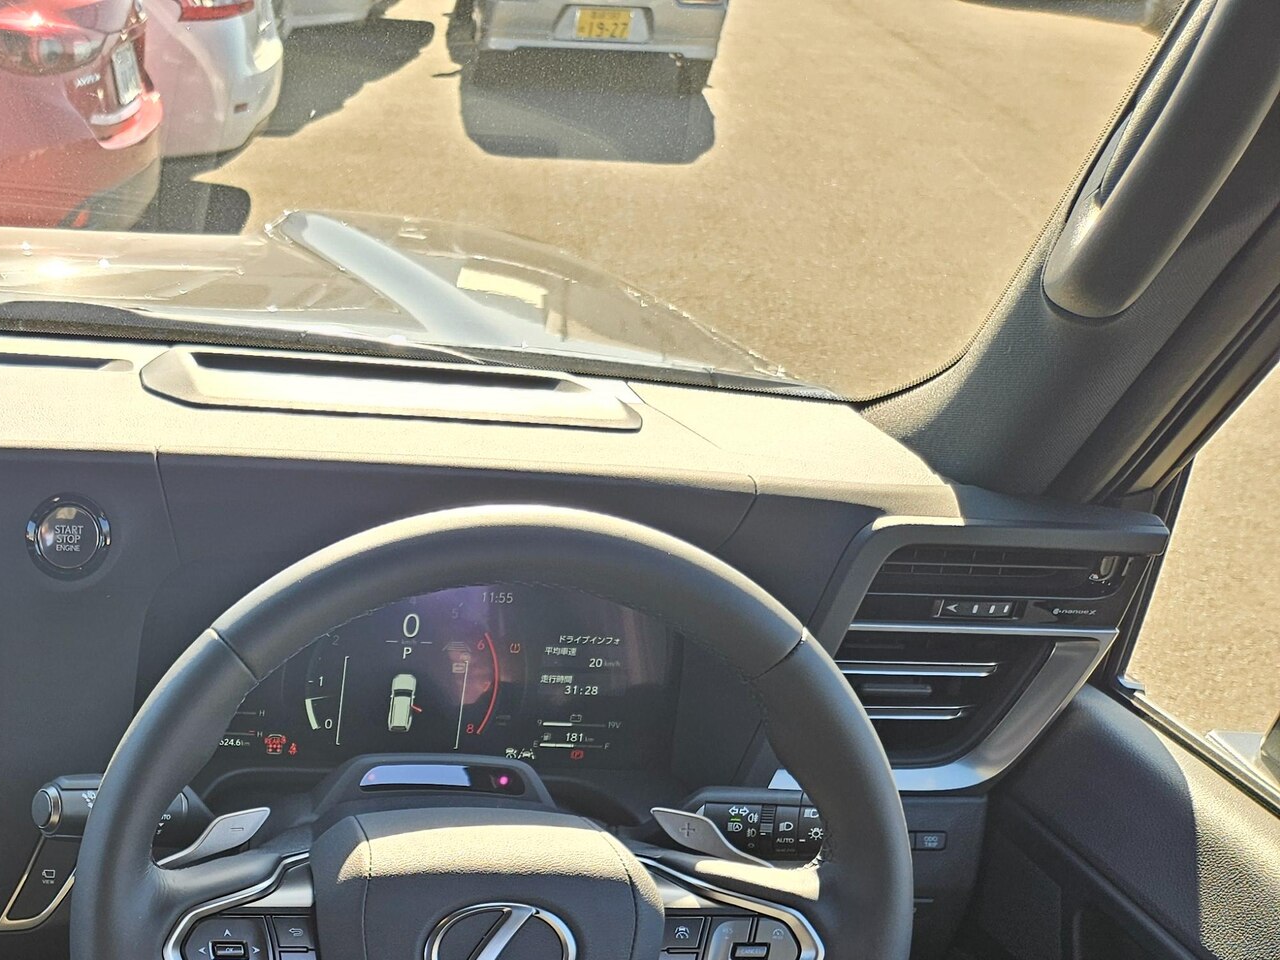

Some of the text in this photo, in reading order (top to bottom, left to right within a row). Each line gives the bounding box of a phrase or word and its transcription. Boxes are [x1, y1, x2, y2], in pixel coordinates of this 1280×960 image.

[54, 525, 84, 534] START
[56, 534, 81, 543] STOP
[55, 544, 80, 552] ENGINE
[481, 592, 514, 604] 11:55
[402, 613, 420, 638] 0
[477, 640, 485, 650] 6
[559, 635, 620, 645] ドライブインフォ
[402, 647, 412, 659] P
[588, 658, 603, 668] 20
[564, 685, 599, 695] 31:28
[324, 719, 333, 730] 0
[466, 723, 474, 733] 8
[566, 732, 584, 742] 181
